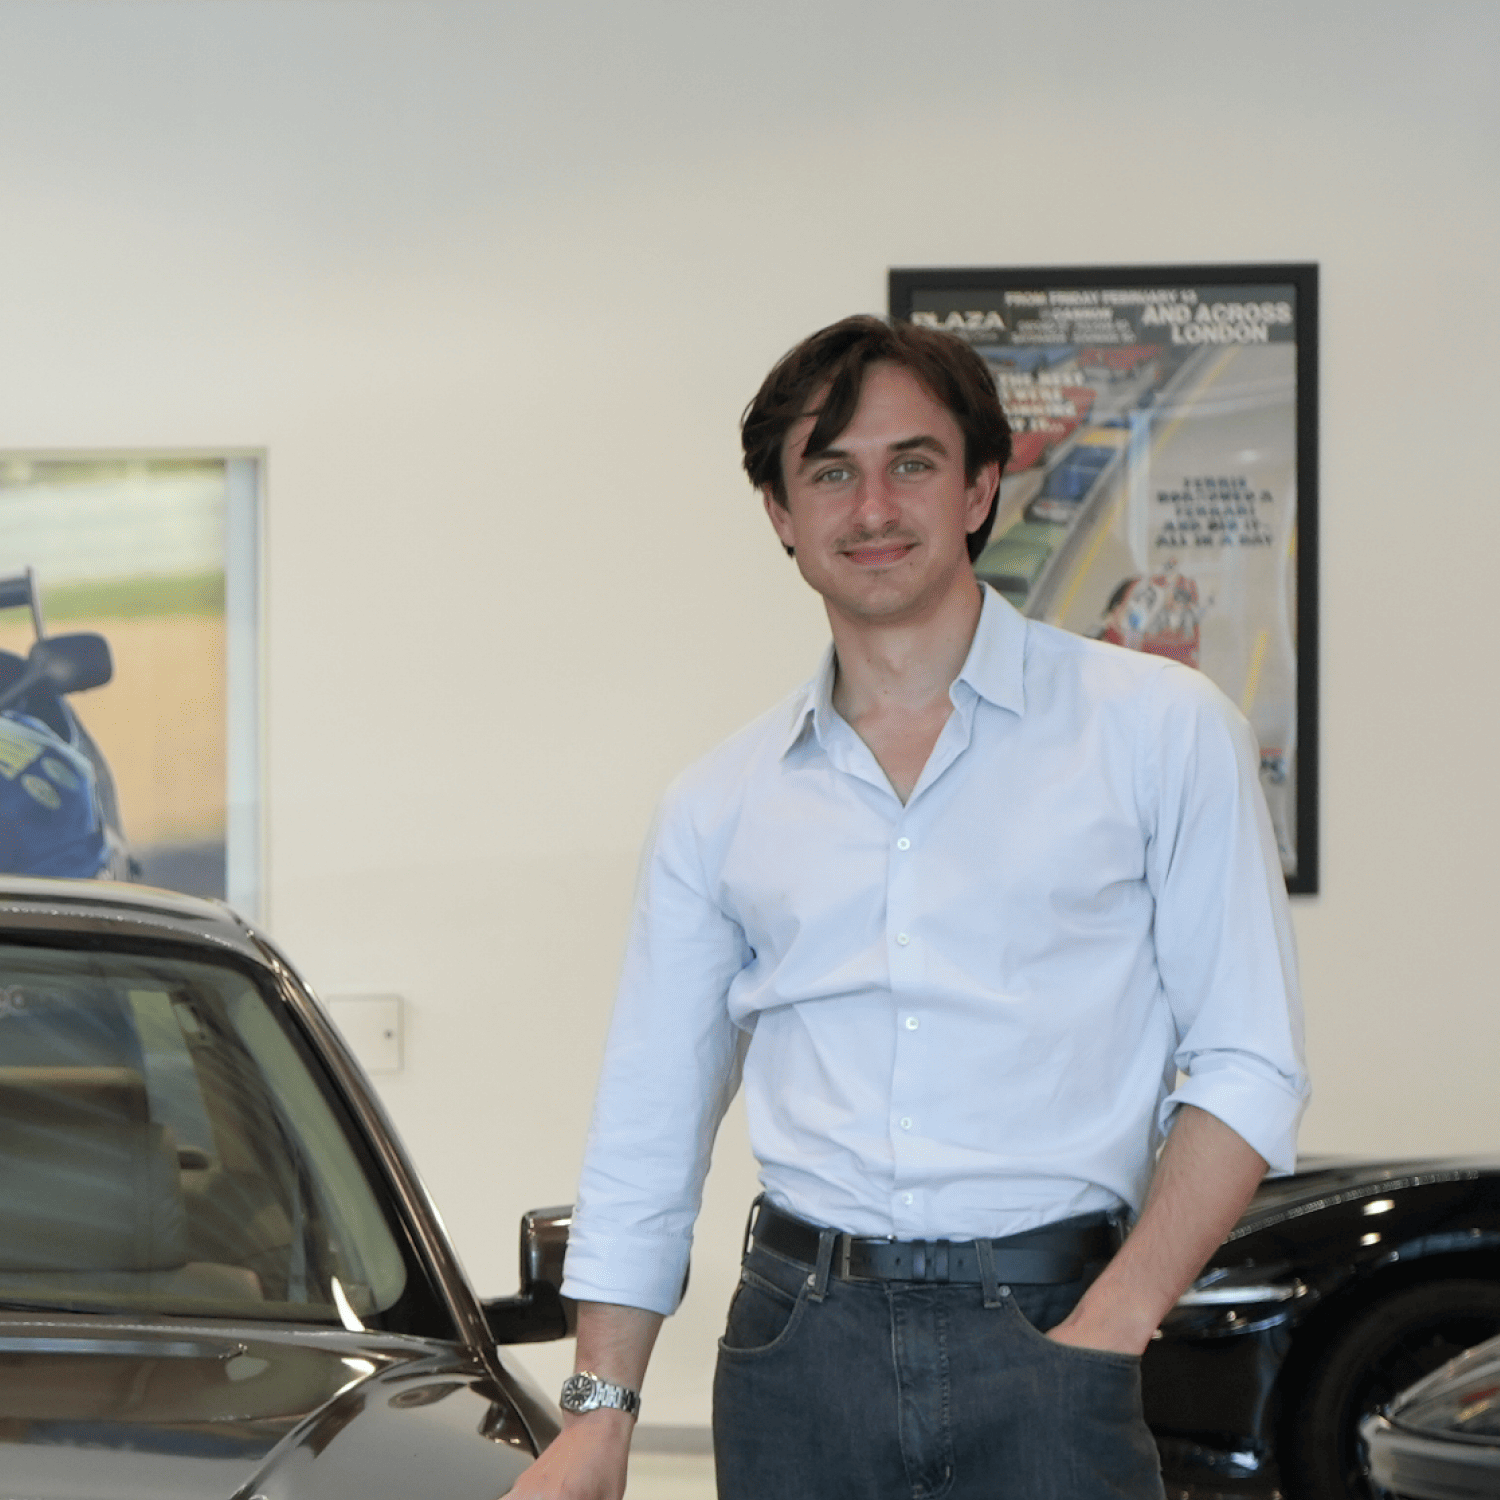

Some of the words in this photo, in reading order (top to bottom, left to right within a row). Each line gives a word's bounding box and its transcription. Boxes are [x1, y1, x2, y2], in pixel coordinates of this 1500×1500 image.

[1142, 303, 1191, 325] AND
[1195, 302, 1293, 324] ACROSS
[1171, 323, 1268, 344] LONDON
